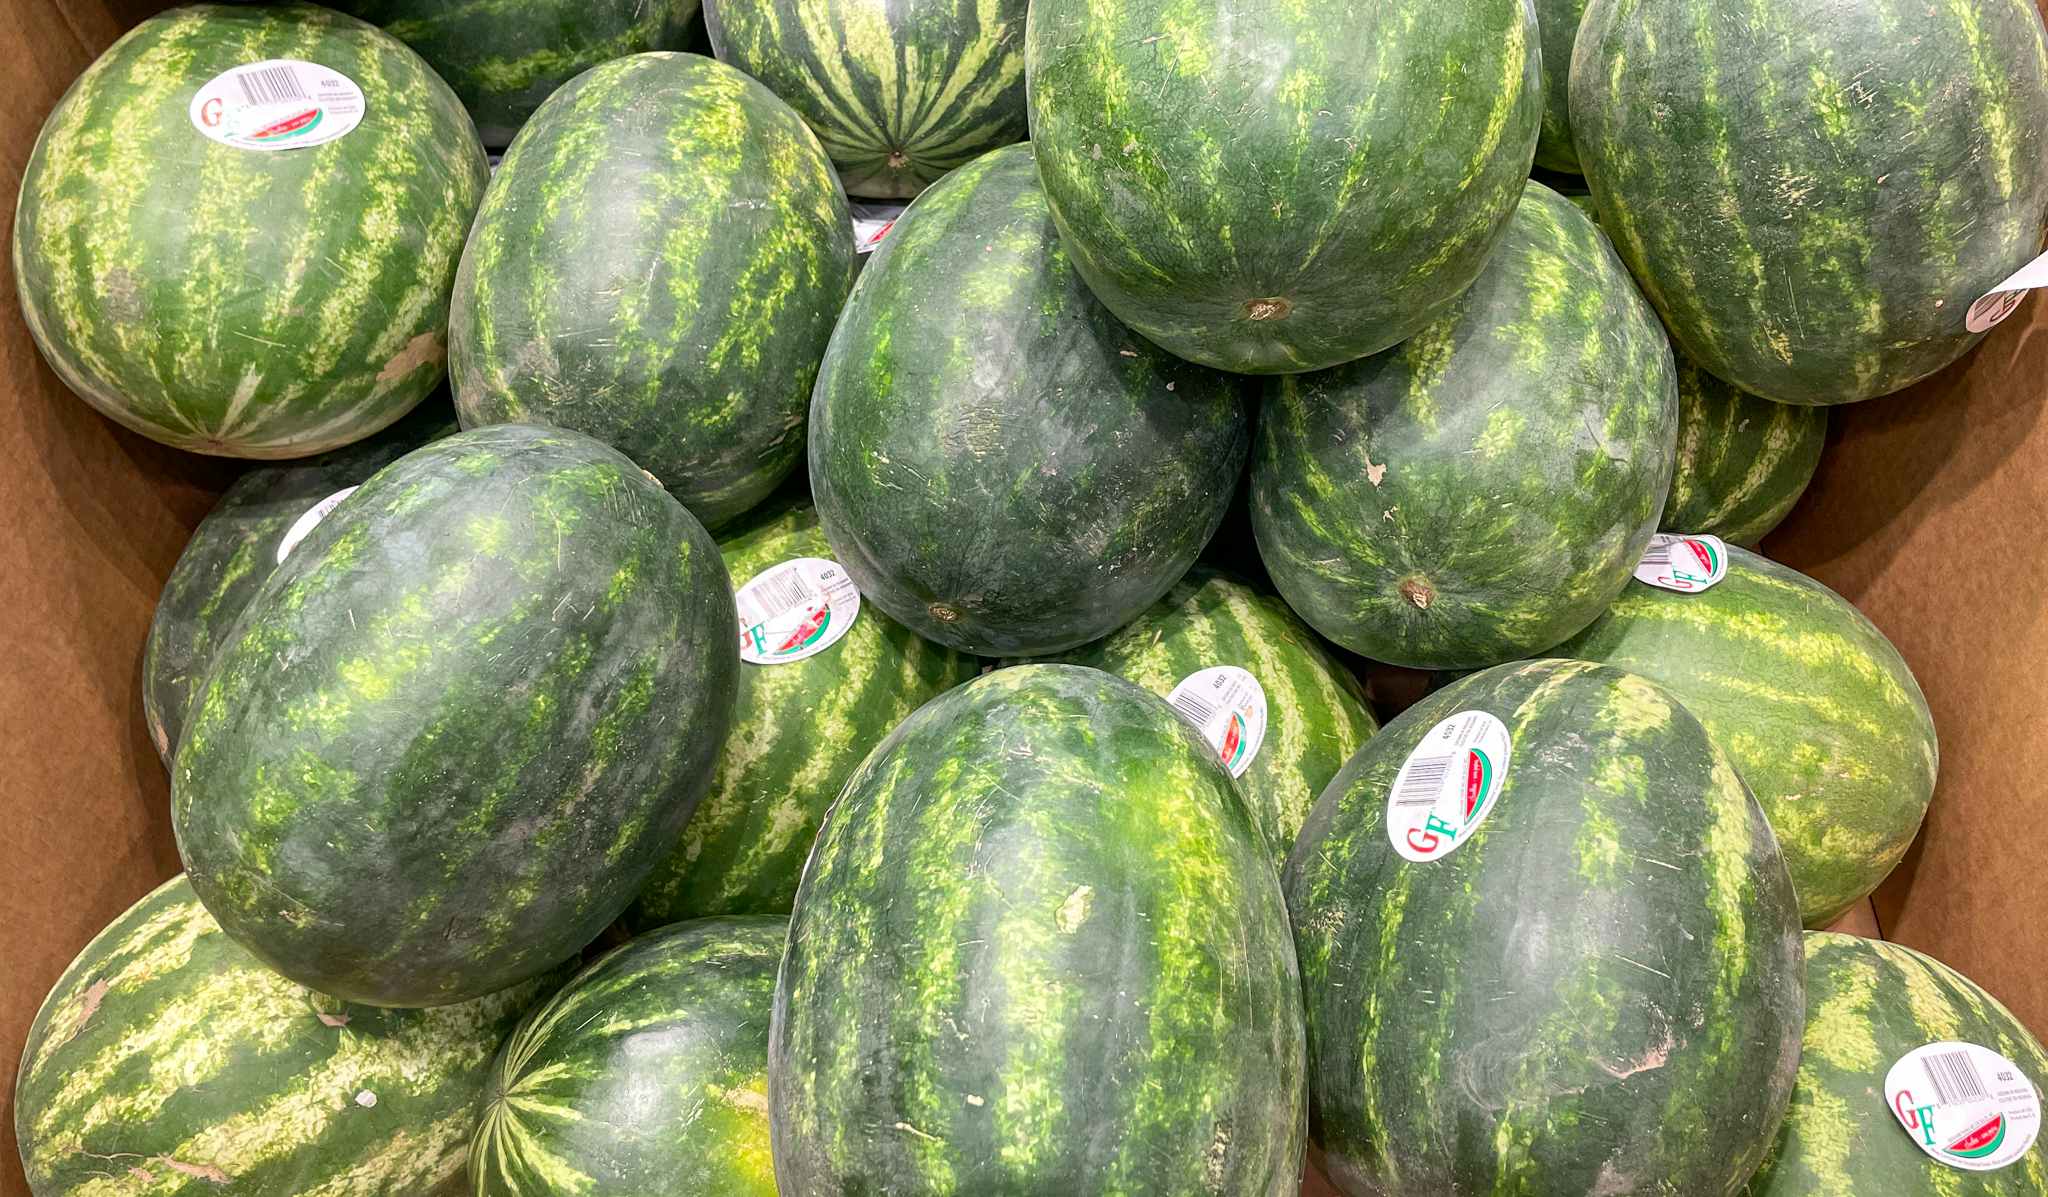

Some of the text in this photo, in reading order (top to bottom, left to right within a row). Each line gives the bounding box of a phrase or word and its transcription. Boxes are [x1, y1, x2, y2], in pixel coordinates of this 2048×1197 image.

[820, 569, 835, 580] 4032
[1212, 674, 1227, 688] 4032
[1407, 813, 1458, 853] GF
[1996, 1071, 2014, 1081] 4032
[1895, 1089, 1936, 1145] GF
